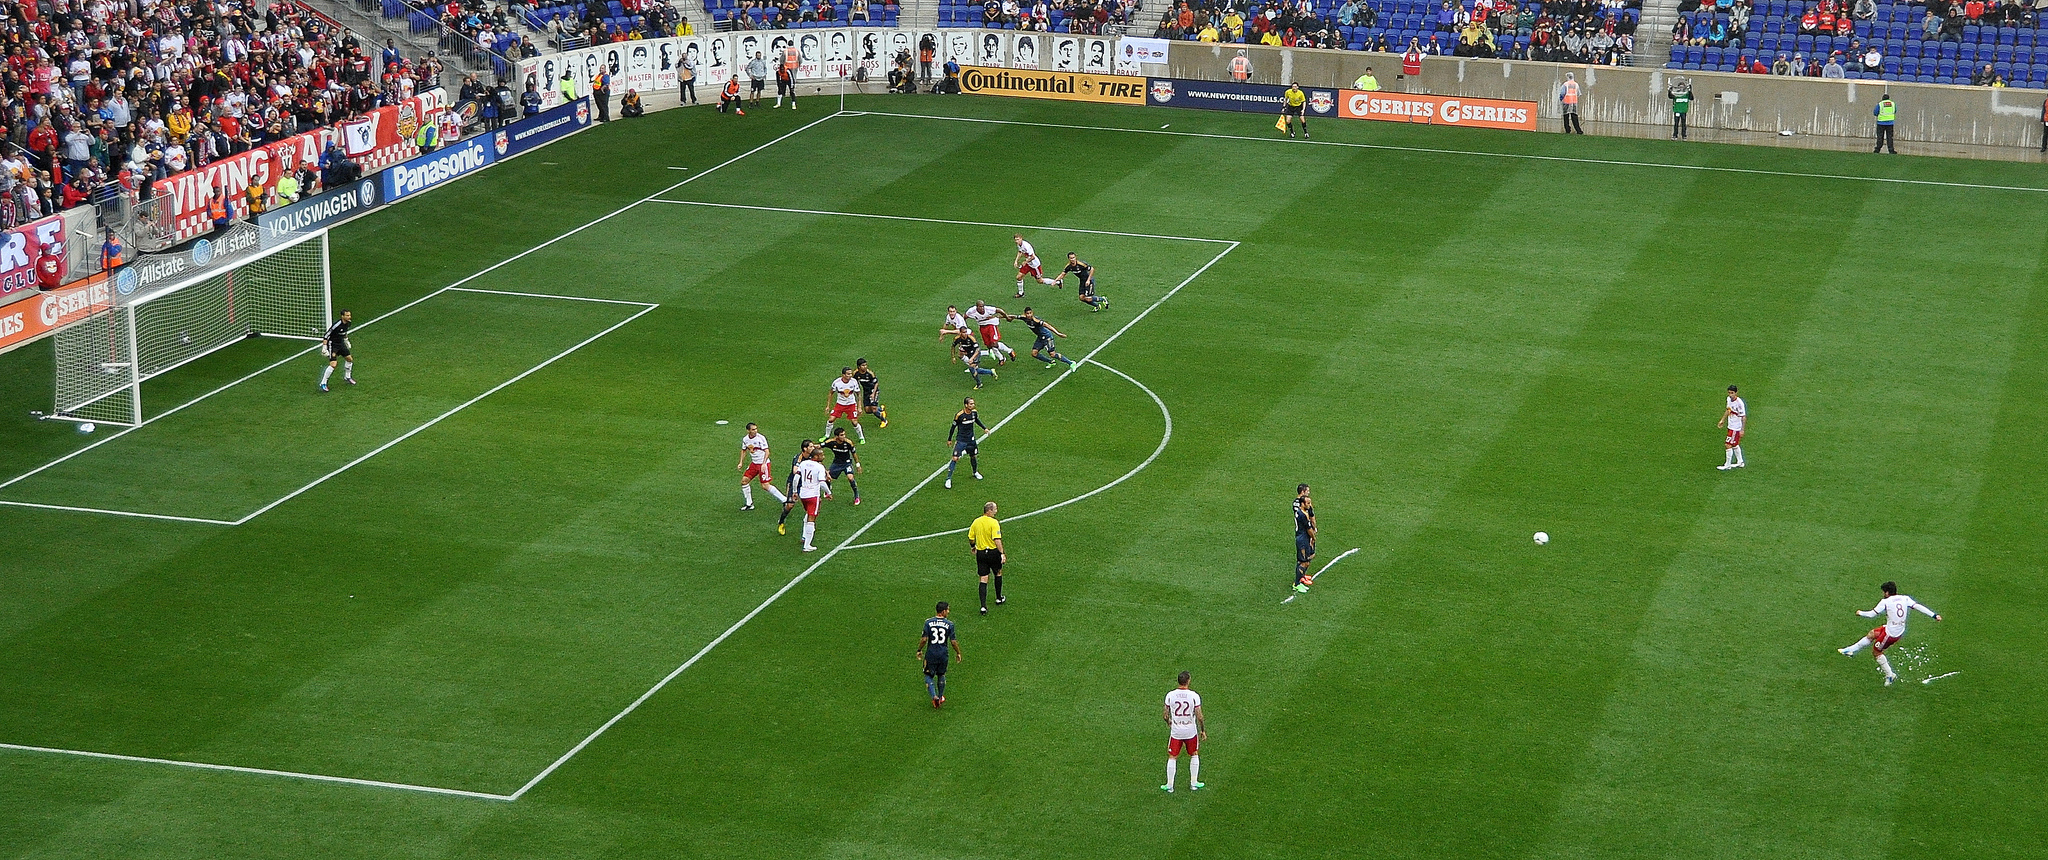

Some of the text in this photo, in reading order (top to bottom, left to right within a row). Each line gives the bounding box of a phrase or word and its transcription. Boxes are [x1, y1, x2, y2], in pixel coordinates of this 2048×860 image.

[799, 64, 817, 72] GREAT
[827, 64, 852, 72] LEAER
[861, 60, 880, 69] BOSS
[628, 73, 652, 83] MASTER
[663, 80, 670, 88] 25
[962, 69, 1143, 98] Continental TIRE
[542, 90, 557, 101] SPEED
[1187, 90, 1289, 103] WWW.NEWYORKREDBULLS.C
[1369, 99, 1434, 118] SERIES
[1461, 104, 1528, 124] SERIES
[394, 141, 485, 196] Panasonic
[164, 150, 269, 216] VIKING
[269, 189, 357, 238] VOLKSWAGEN
[213, 230, 256, 259] Alstate
[139, 256, 185, 287] Allstate
[3, 268, 36, 293] CLU
[804, 469, 813, 483] 14
[1896, 603, 1905, 618] 8
[930, 627, 946, 645] 33
[1174, 701, 1190, 717] 22
